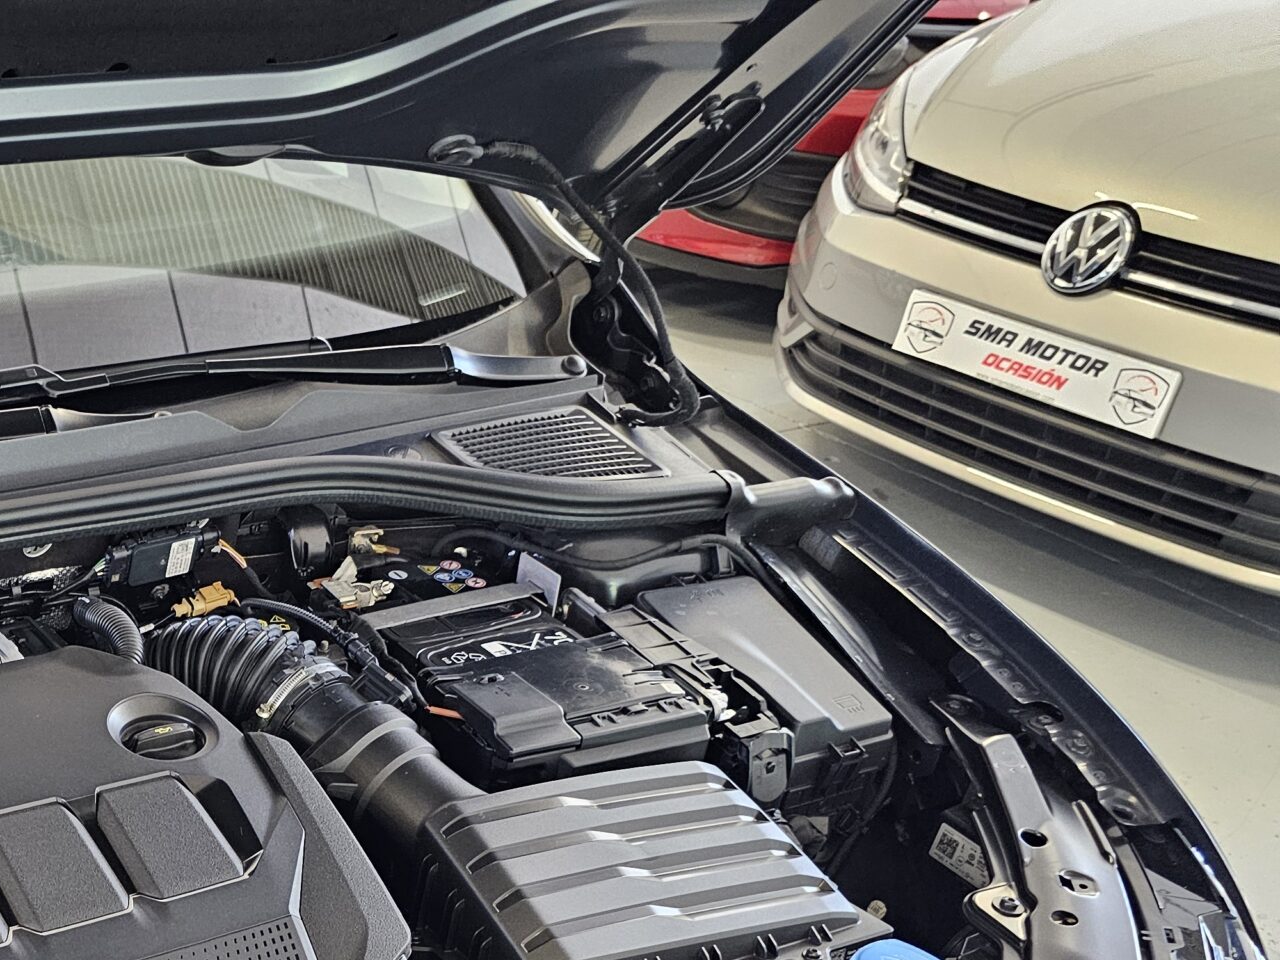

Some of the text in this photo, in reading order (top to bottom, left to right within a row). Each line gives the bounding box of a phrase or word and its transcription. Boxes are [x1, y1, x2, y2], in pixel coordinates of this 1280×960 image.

[963, 319, 1109, 378] SMA MOTOR
[981, 353, 1069, 391] OCASIÓN
